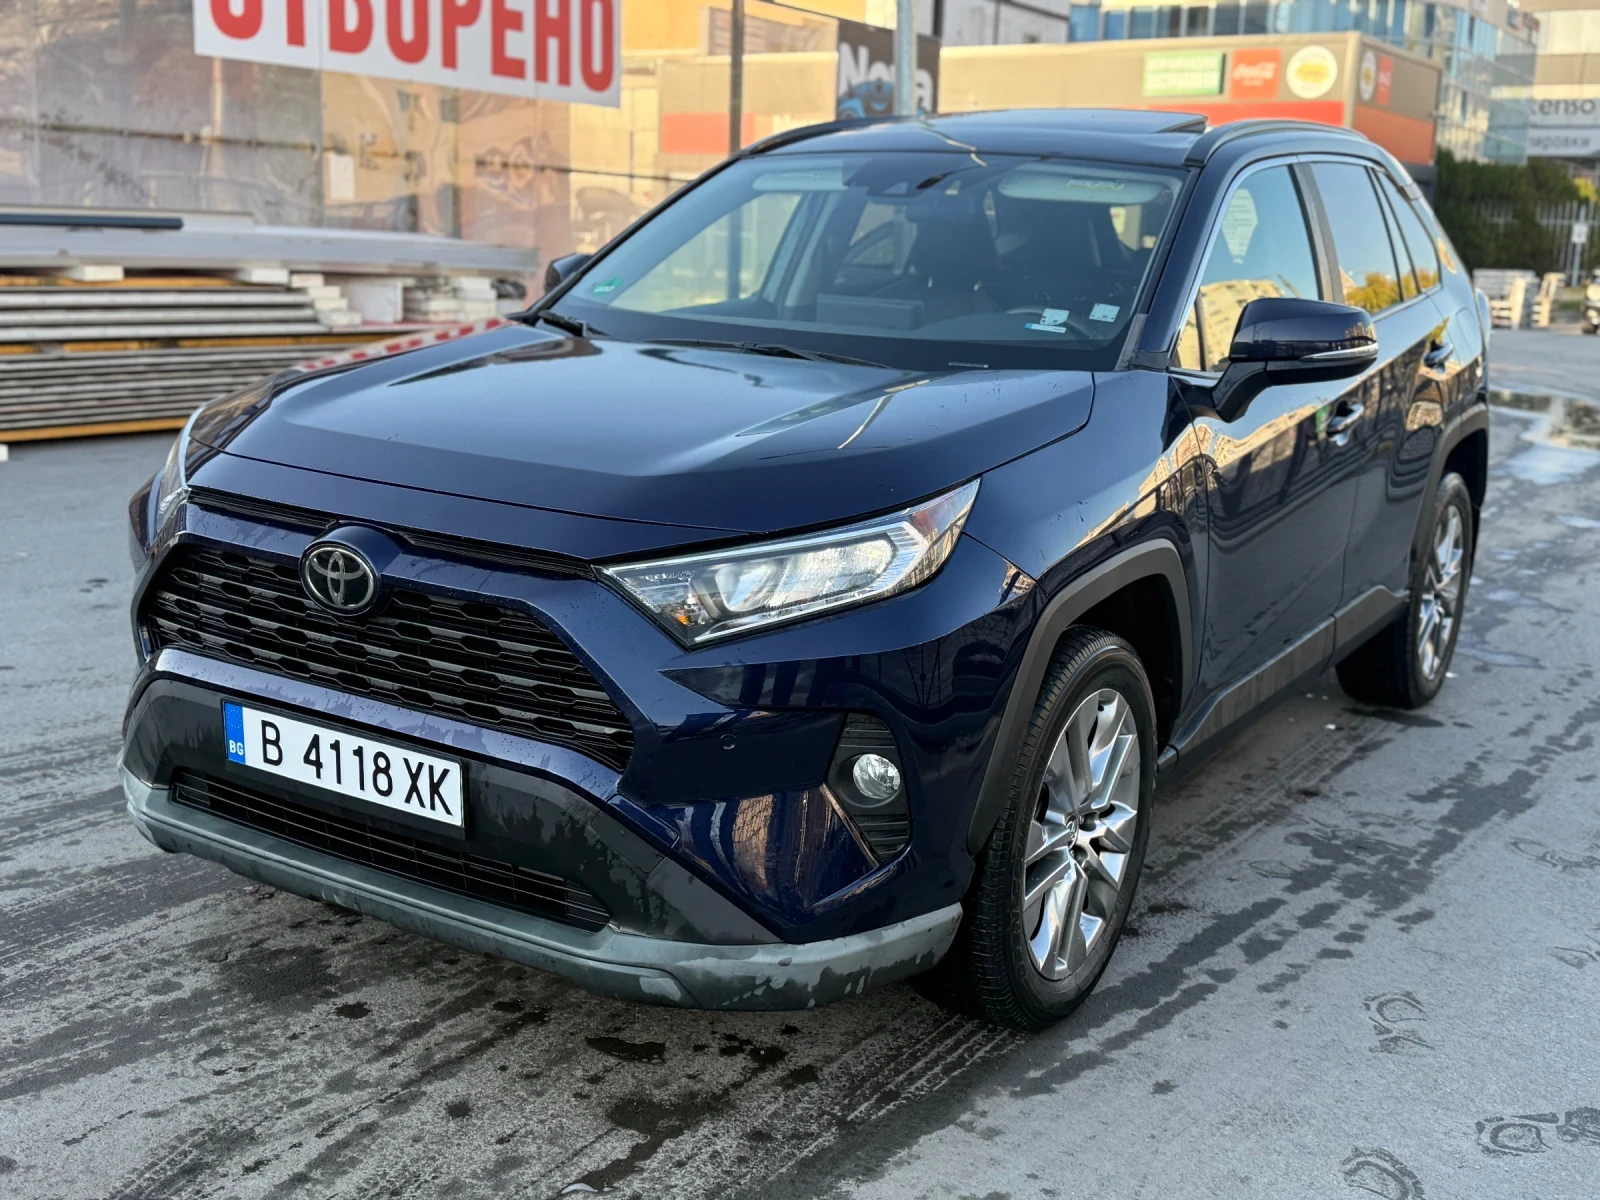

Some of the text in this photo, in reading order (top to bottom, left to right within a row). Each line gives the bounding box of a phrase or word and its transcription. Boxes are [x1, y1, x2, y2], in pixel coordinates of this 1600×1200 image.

[208, 0, 615, 93] ОРЕНО
[838, 42, 934, 112] Noa
[229, 739, 244, 756] BG
[261, 719, 453, 816] B 4118 XK
